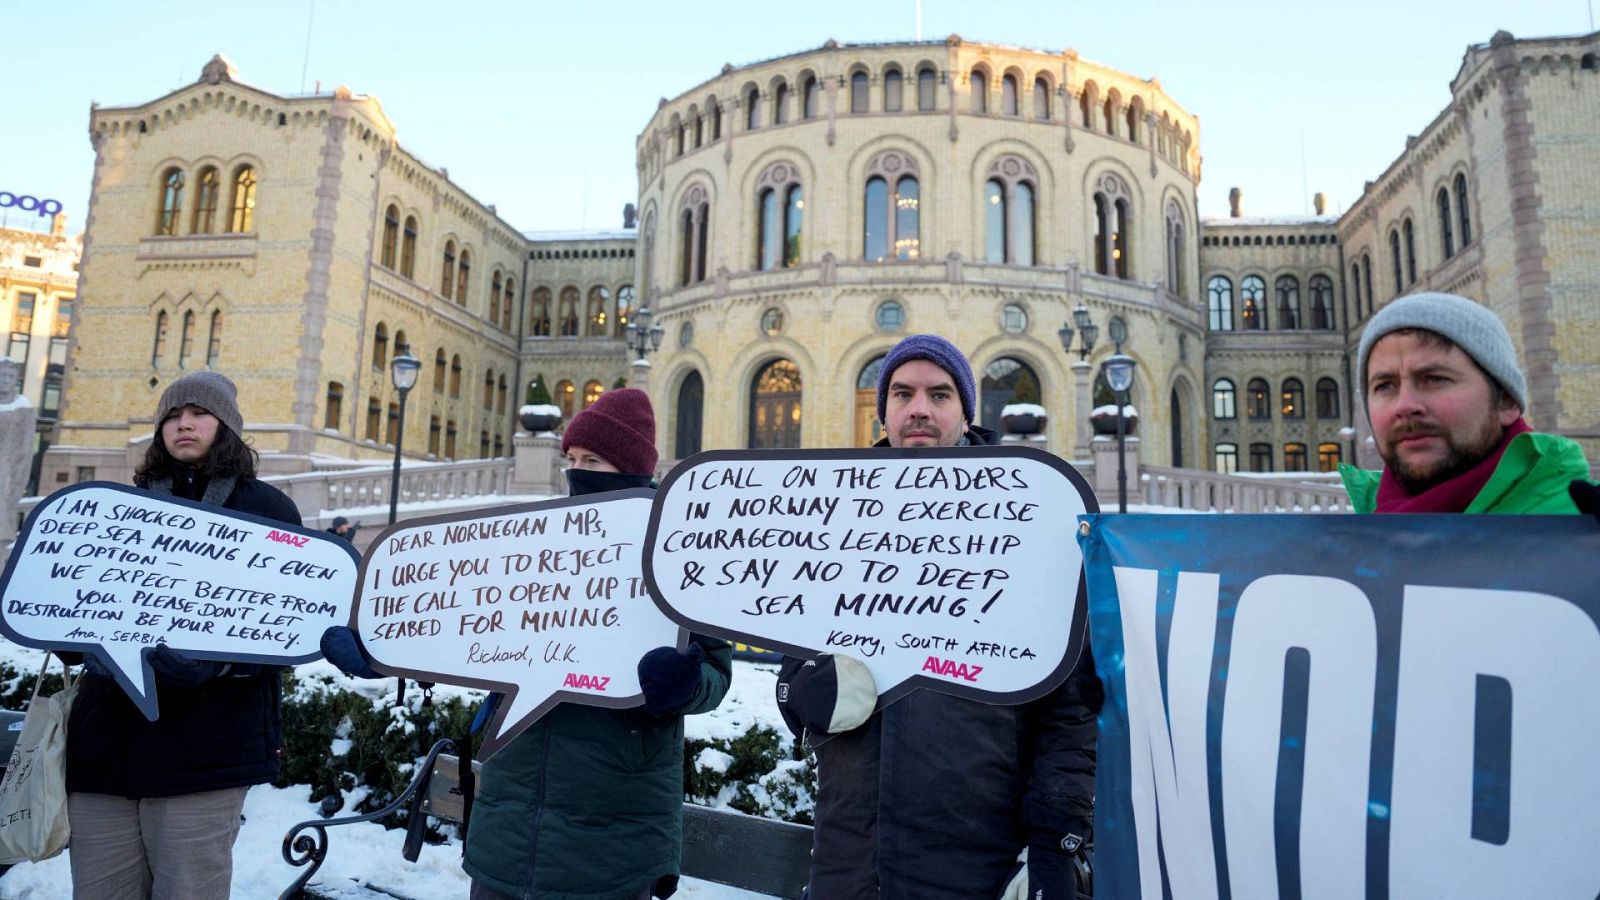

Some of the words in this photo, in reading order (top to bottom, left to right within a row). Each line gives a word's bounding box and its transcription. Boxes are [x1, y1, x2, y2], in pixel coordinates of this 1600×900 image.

[688, 470, 696, 491] I
[702, 469, 763, 491] CALL
[783, 466, 817, 488] ON
[832, 467, 887, 489] THE
[895, 466, 1029, 492] LEADERS
[56, 498, 66, 514] I
[68, 500, 99, 517] AM
[104, 505, 196, 531] SHOCKED
[207, 522, 253, 543] THAT
[686, 501, 709, 521] IN
[728, 497, 839, 526] NORWAY
[852, 499, 883, 518] TO
[898, 501, 1039, 523] EXERCISE
[39, 518, 99, 535] DEEP
[97, 526, 144, 545] SEA
[152, 534, 240, 561] MINING
[247, 553, 276, 569] IS
[280, 561, 338, 580] EVEN
[265, 530, 310, 548] AVAAZ
[390, 531, 435, 555] DEAR
[443, 516, 548, 545] NORWEGIAN
[664, 529, 829, 553] COURAGEOUS
[839, 529, 1021, 555] LEADERSHIP
[31, 541, 63, 556] AN
[74, 544, 156, 566] OPTION
[374, 569, 380, 589] I
[392, 562, 440, 587] URGE
[450, 556, 489, 586] YOU
[501, 553, 531, 575] TO
[539, 543, 633, 575] REJECT
[50, 563, 93, 579] WE
[99, 568, 186, 590] EXPECT
[195, 581, 277, 606] BETTER
[281, 597, 336, 617] FROM
[679, 561, 705, 590] &
[716, 559, 779, 589] SAY
[793, 560, 843, 583] NO
[860, 560, 898, 584] TO
[916, 562, 1009, 590] DEEP
[76, 589, 122, 608] YOU.
[132, 592, 197, 613] PLEASE
[197, 603, 255, 620] DON'T
[259, 615, 303, 627] LET
[369, 595, 412, 617] THE
[414, 591, 461, 613] CALL
[472, 586, 501, 604] TO
[509, 582, 570, 602] OPEN
[586, 577, 619, 600] UP
[742, 595, 805, 616] SEA
[834, 589, 1004, 624] MINING!
[7, 600, 123, 621] DESTRUCTION
[135, 612, 162, 626] BE
[171, 616, 214, 635] YOUR
[226, 624, 300, 649] LEGACY.
[110, 631, 167, 644] SERBIA
[369, 619, 441, 642] SEABED
[459, 611, 502, 636] FOR
[521, 606, 620, 633] MINING.
[467, 642, 532, 667] Richard,
[544, 640, 579, 663] U.K.
[826, 631, 885, 656] Kerry,
[895, 632, 958, 652] SOUTH
[966, 641, 1036, 659] AFRICA
[563, 673, 610, 690] AVAAZ
[922, 656, 983, 681] AVAAZ
